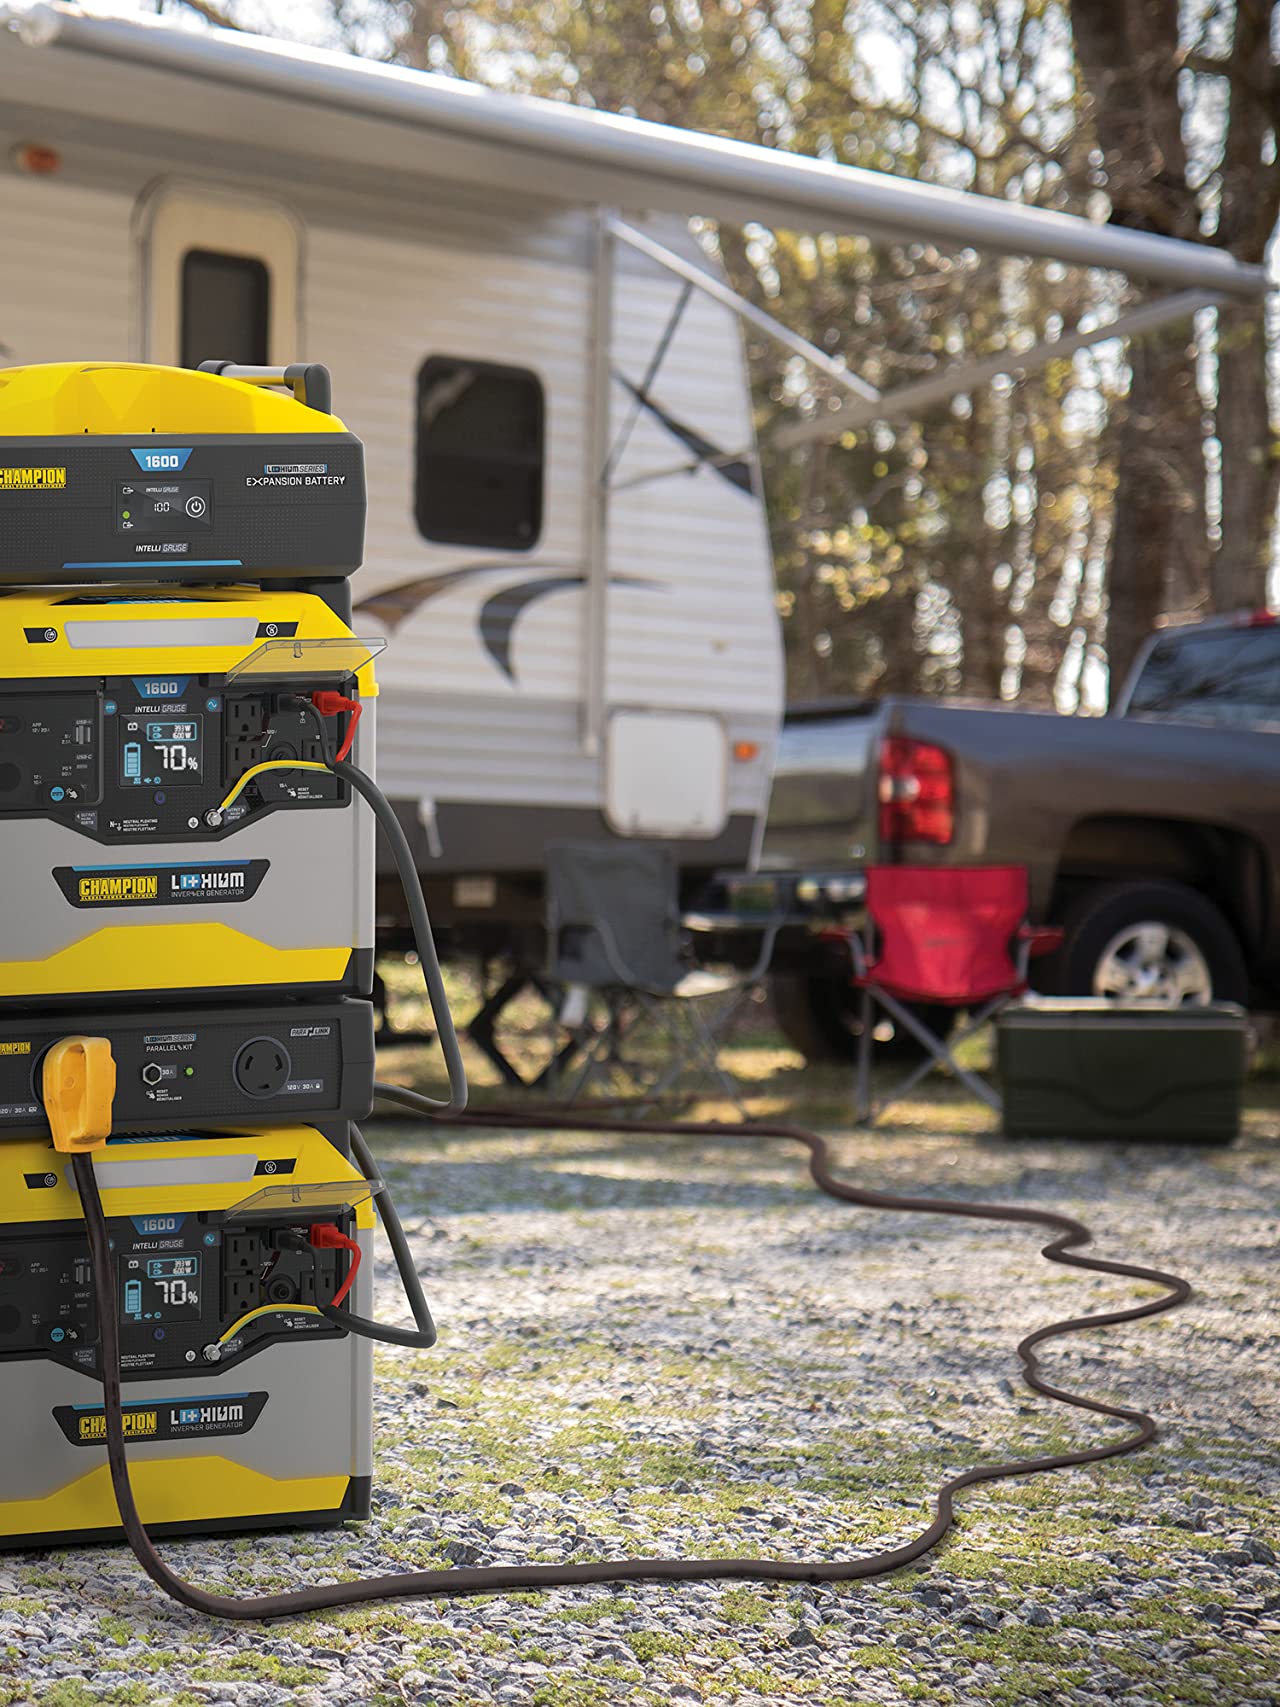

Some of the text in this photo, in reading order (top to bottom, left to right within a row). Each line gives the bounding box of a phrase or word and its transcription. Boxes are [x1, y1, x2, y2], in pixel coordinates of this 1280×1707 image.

[146, 455, 179, 468] 1600
[246, 476, 345, 486] EXPANSION BATTERY
[154, 501, 170, 512] 100
[162, 544, 188, 553] GAUGE
[145, 682, 177, 695] 1600
[134, 704, 187, 713] INTELLI GAUGE
[80, 877, 156, 896] CHAMPION
[206, 888, 244, 897] GENERATOR
[142, 1218, 175, 1231] 1600
[132, 1239, 185, 1250] INTELLI GAUGE
[80, 1412, 156, 1434] CHAPION
[205, 1421, 243, 1430] GENERATOR
